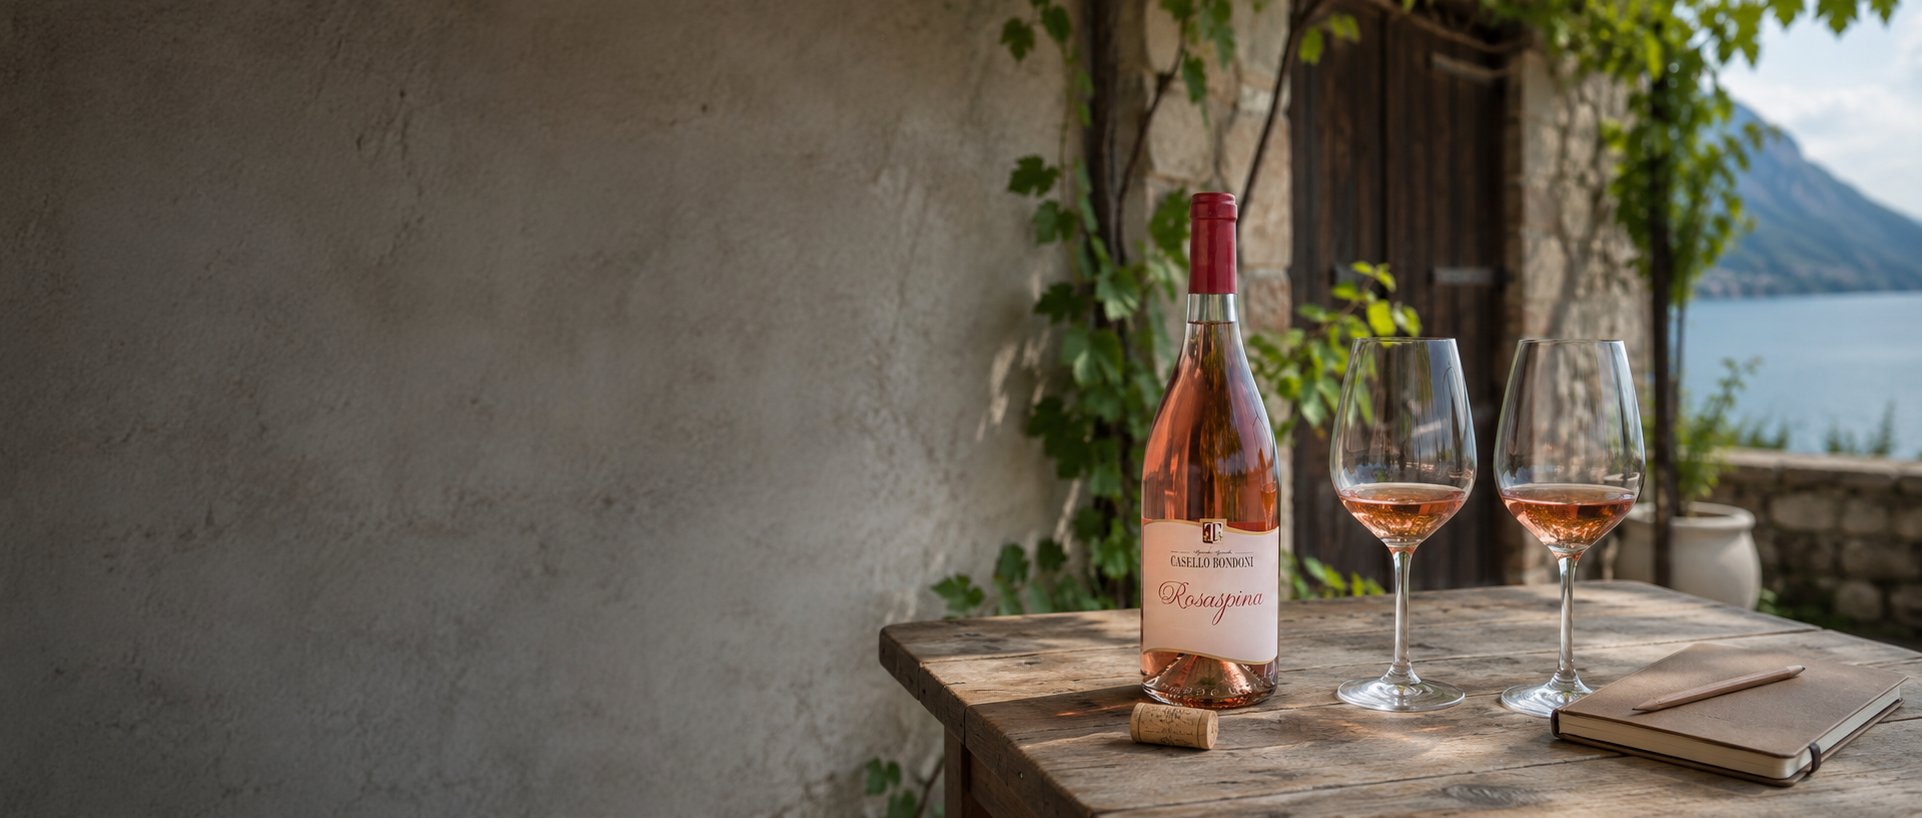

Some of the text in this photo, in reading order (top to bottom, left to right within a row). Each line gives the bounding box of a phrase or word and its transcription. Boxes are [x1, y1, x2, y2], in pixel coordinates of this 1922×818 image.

[1170, 555, 1254, 568] CASELLO BONDONI
[1159, 581, 1263, 626] Rosaspina
